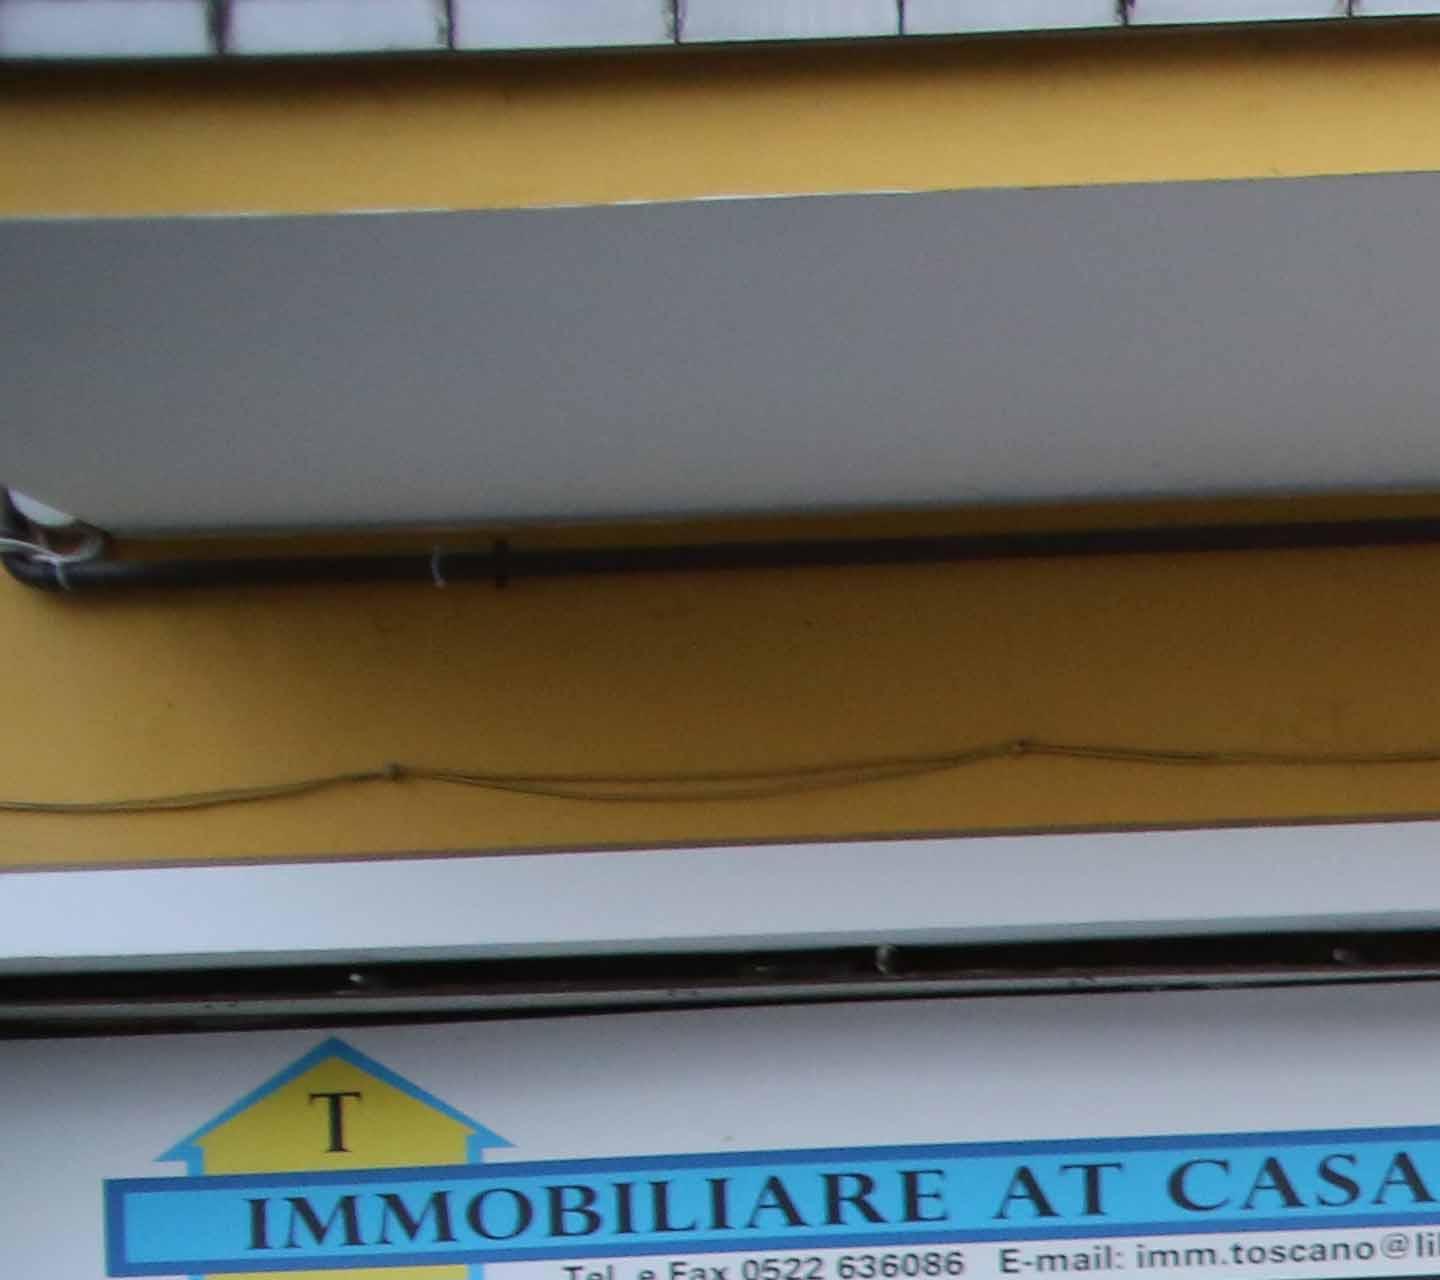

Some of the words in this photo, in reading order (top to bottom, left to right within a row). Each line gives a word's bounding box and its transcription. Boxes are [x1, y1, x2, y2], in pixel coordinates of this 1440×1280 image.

[308, 1090, 363, 1153] T
[245, 1168, 950, 1251] IMMOBILIARE
[992, 1161, 1124, 1221] AT
[1166, 1150, 1440, 1213] CASA
[837, 1251, 966, 1280] 636086
[999, 1245, 1125, 1275] E-mail:
